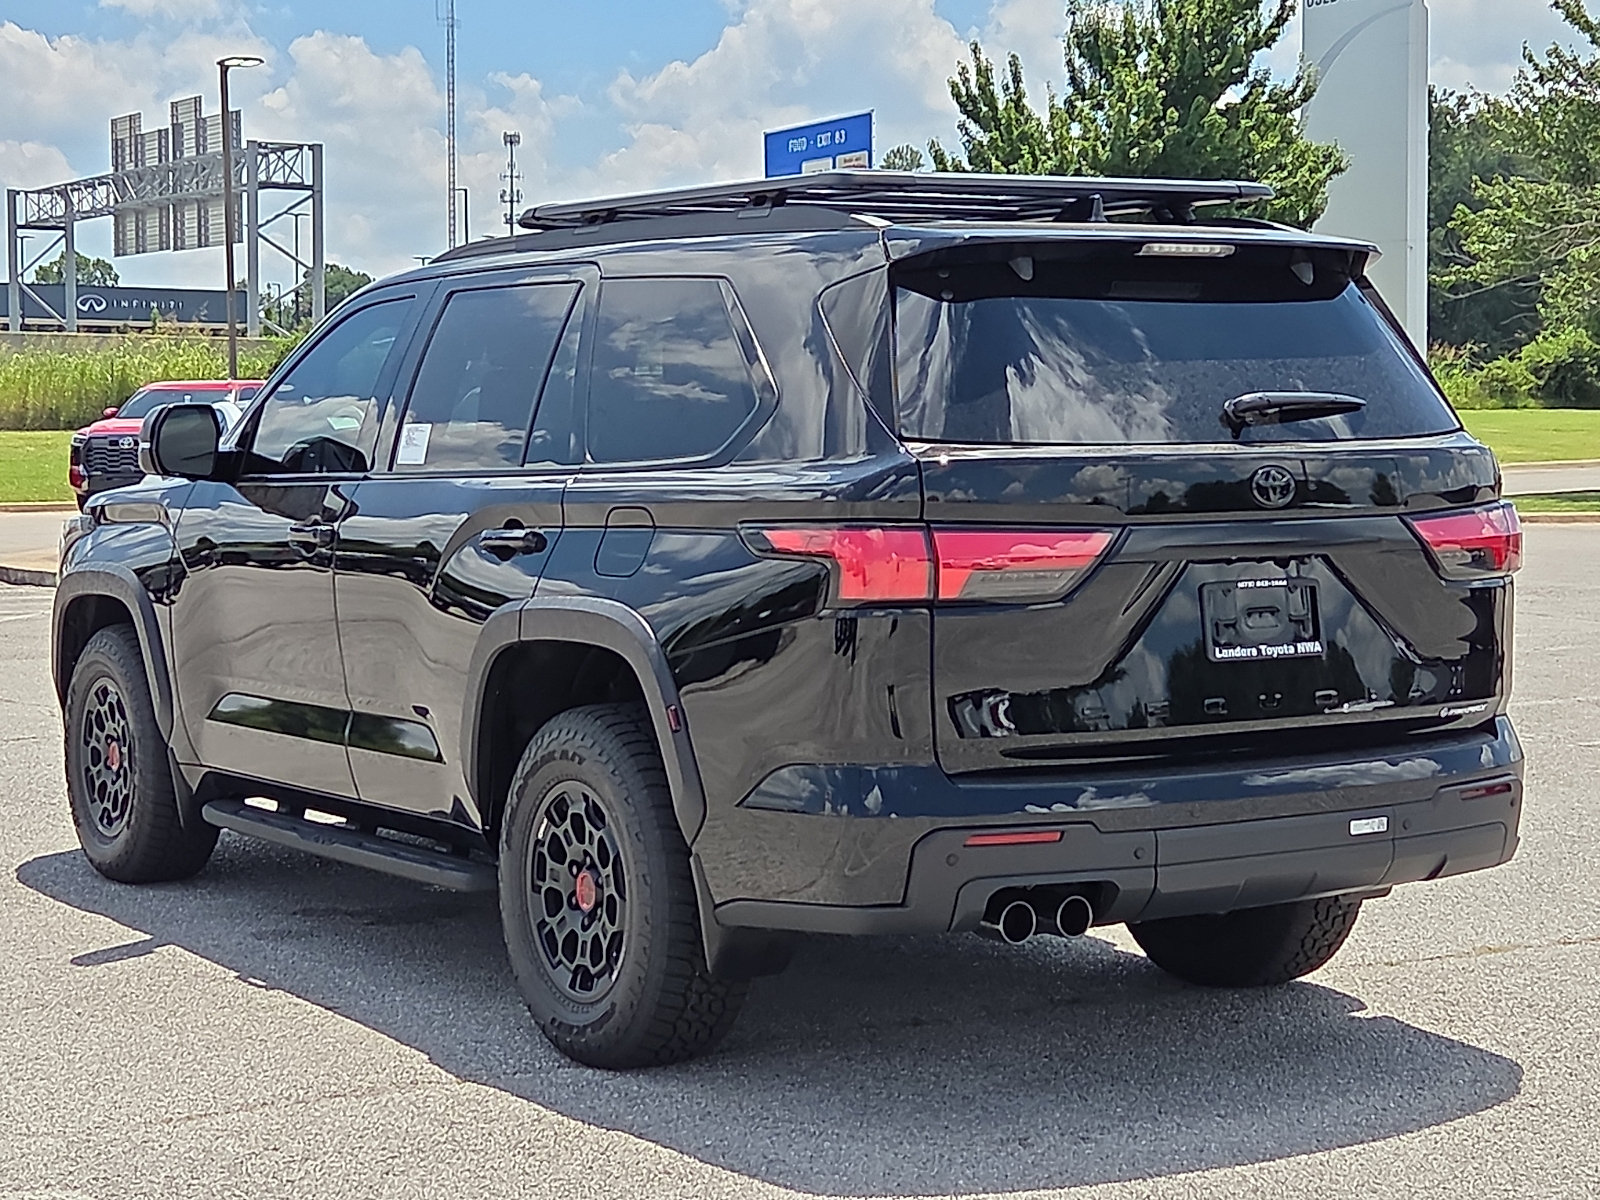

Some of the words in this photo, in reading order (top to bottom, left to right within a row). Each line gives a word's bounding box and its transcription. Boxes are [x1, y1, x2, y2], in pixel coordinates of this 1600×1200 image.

[817, 131, 832, 148] EXIT
[113, 299, 183, 310] INFINITI
[1259, 643, 1295, 658] Toyota
[1296, 641, 1322, 654] NWA
